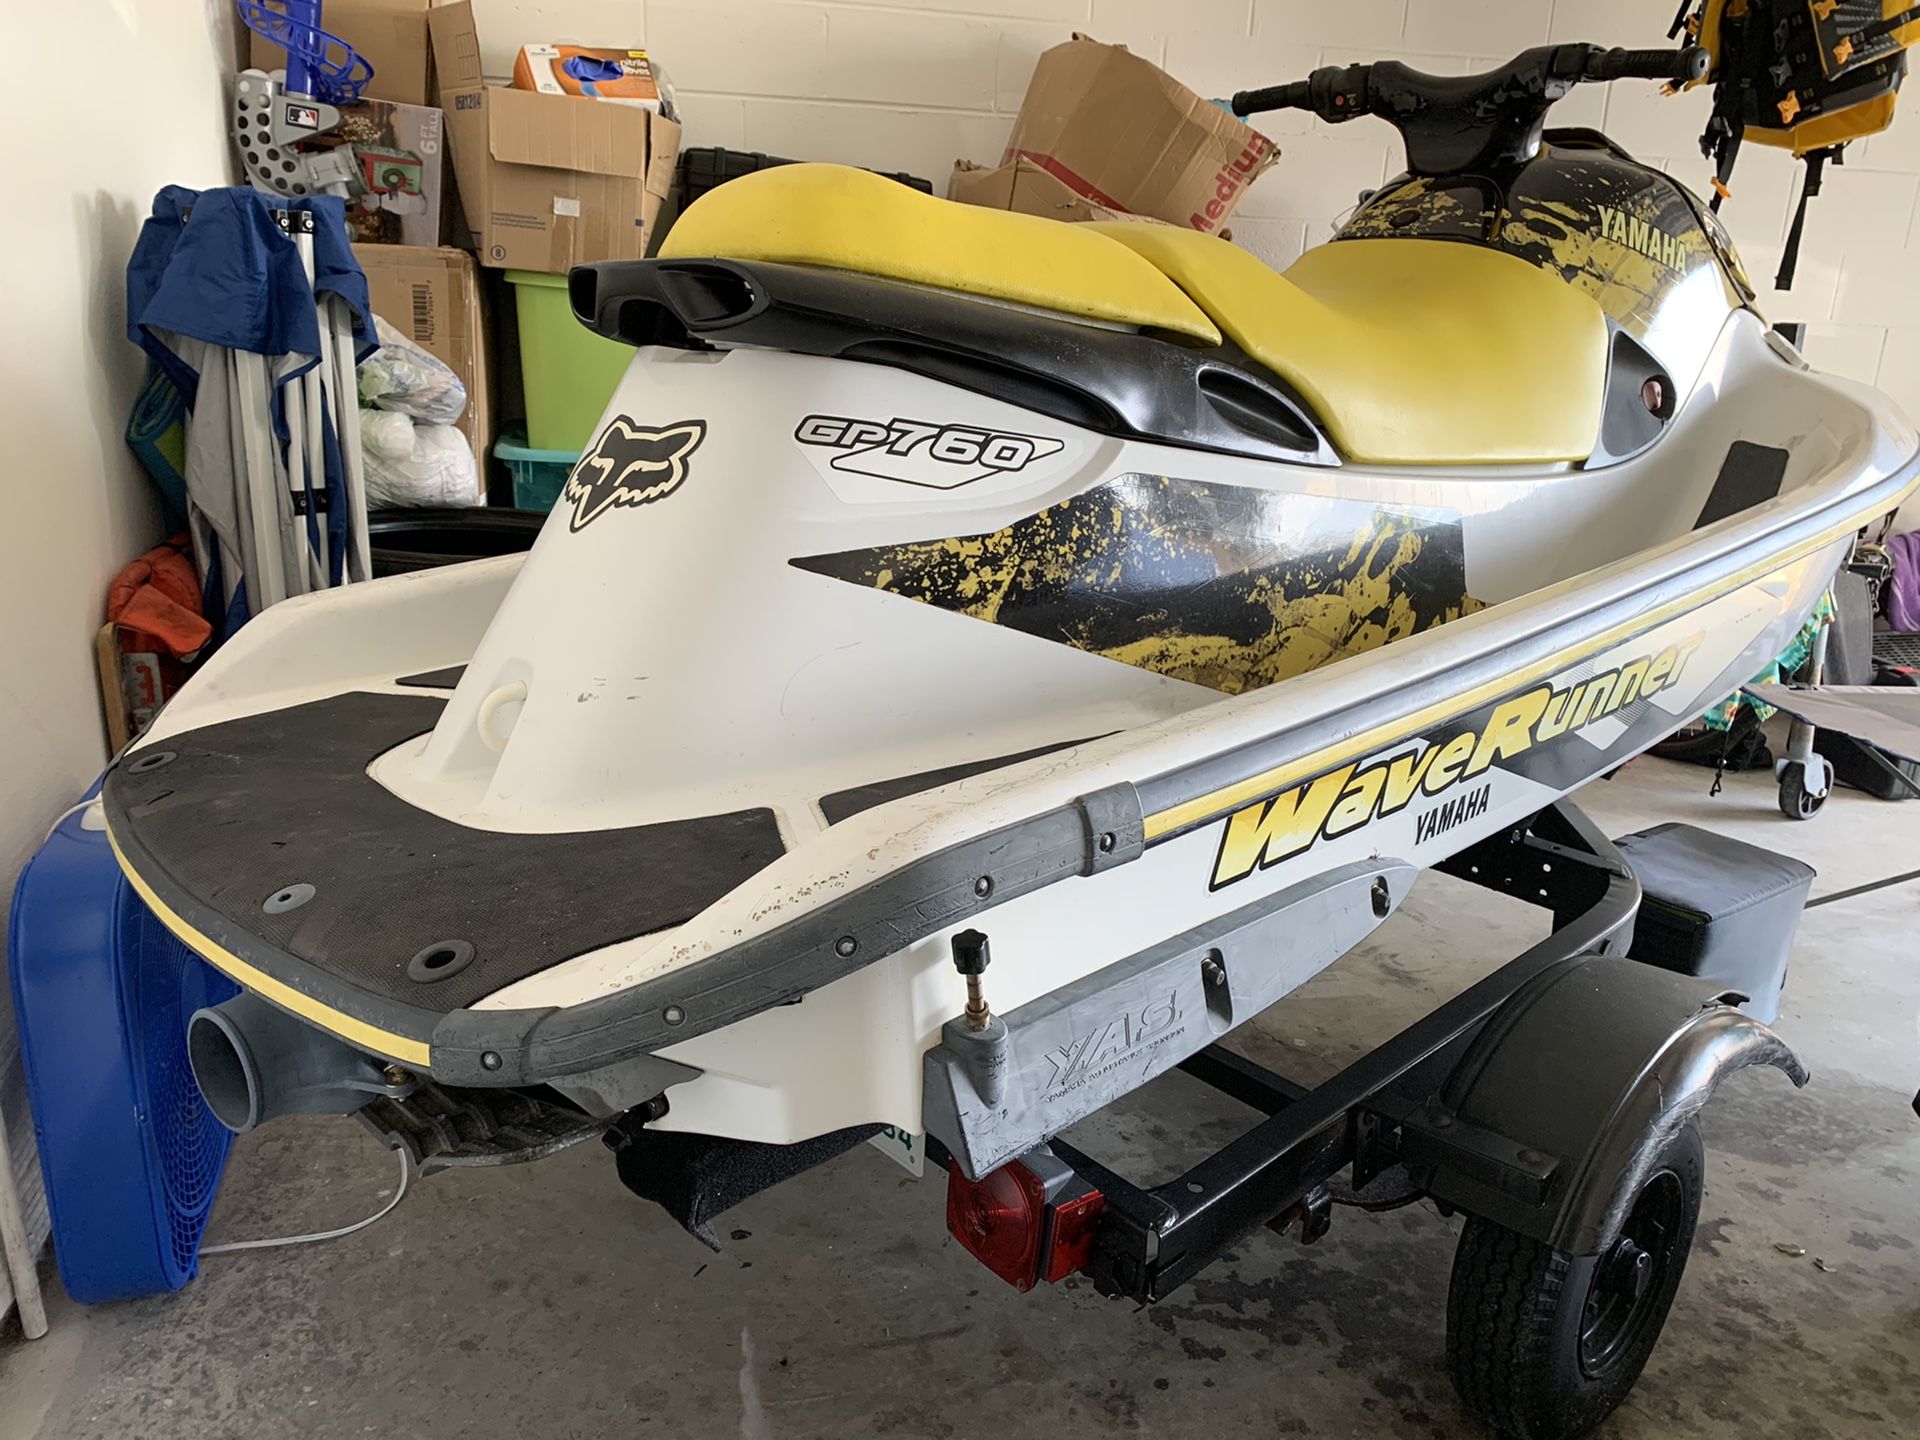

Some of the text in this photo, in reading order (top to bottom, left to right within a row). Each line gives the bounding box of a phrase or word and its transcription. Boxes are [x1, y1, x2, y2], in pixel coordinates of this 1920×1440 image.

[620, 59, 648, 67] nitrile
[420, 125, 438, 155] 6 FT
[430, 111, 439, 140] TALL
[1597, 204, 1687, 277] YAMAHA
[794, 414, 1035, 472] GP760
[1209, 632, 1706, 892] WaveRunner
[1414, 783, 1492, 847] YAMAHA
